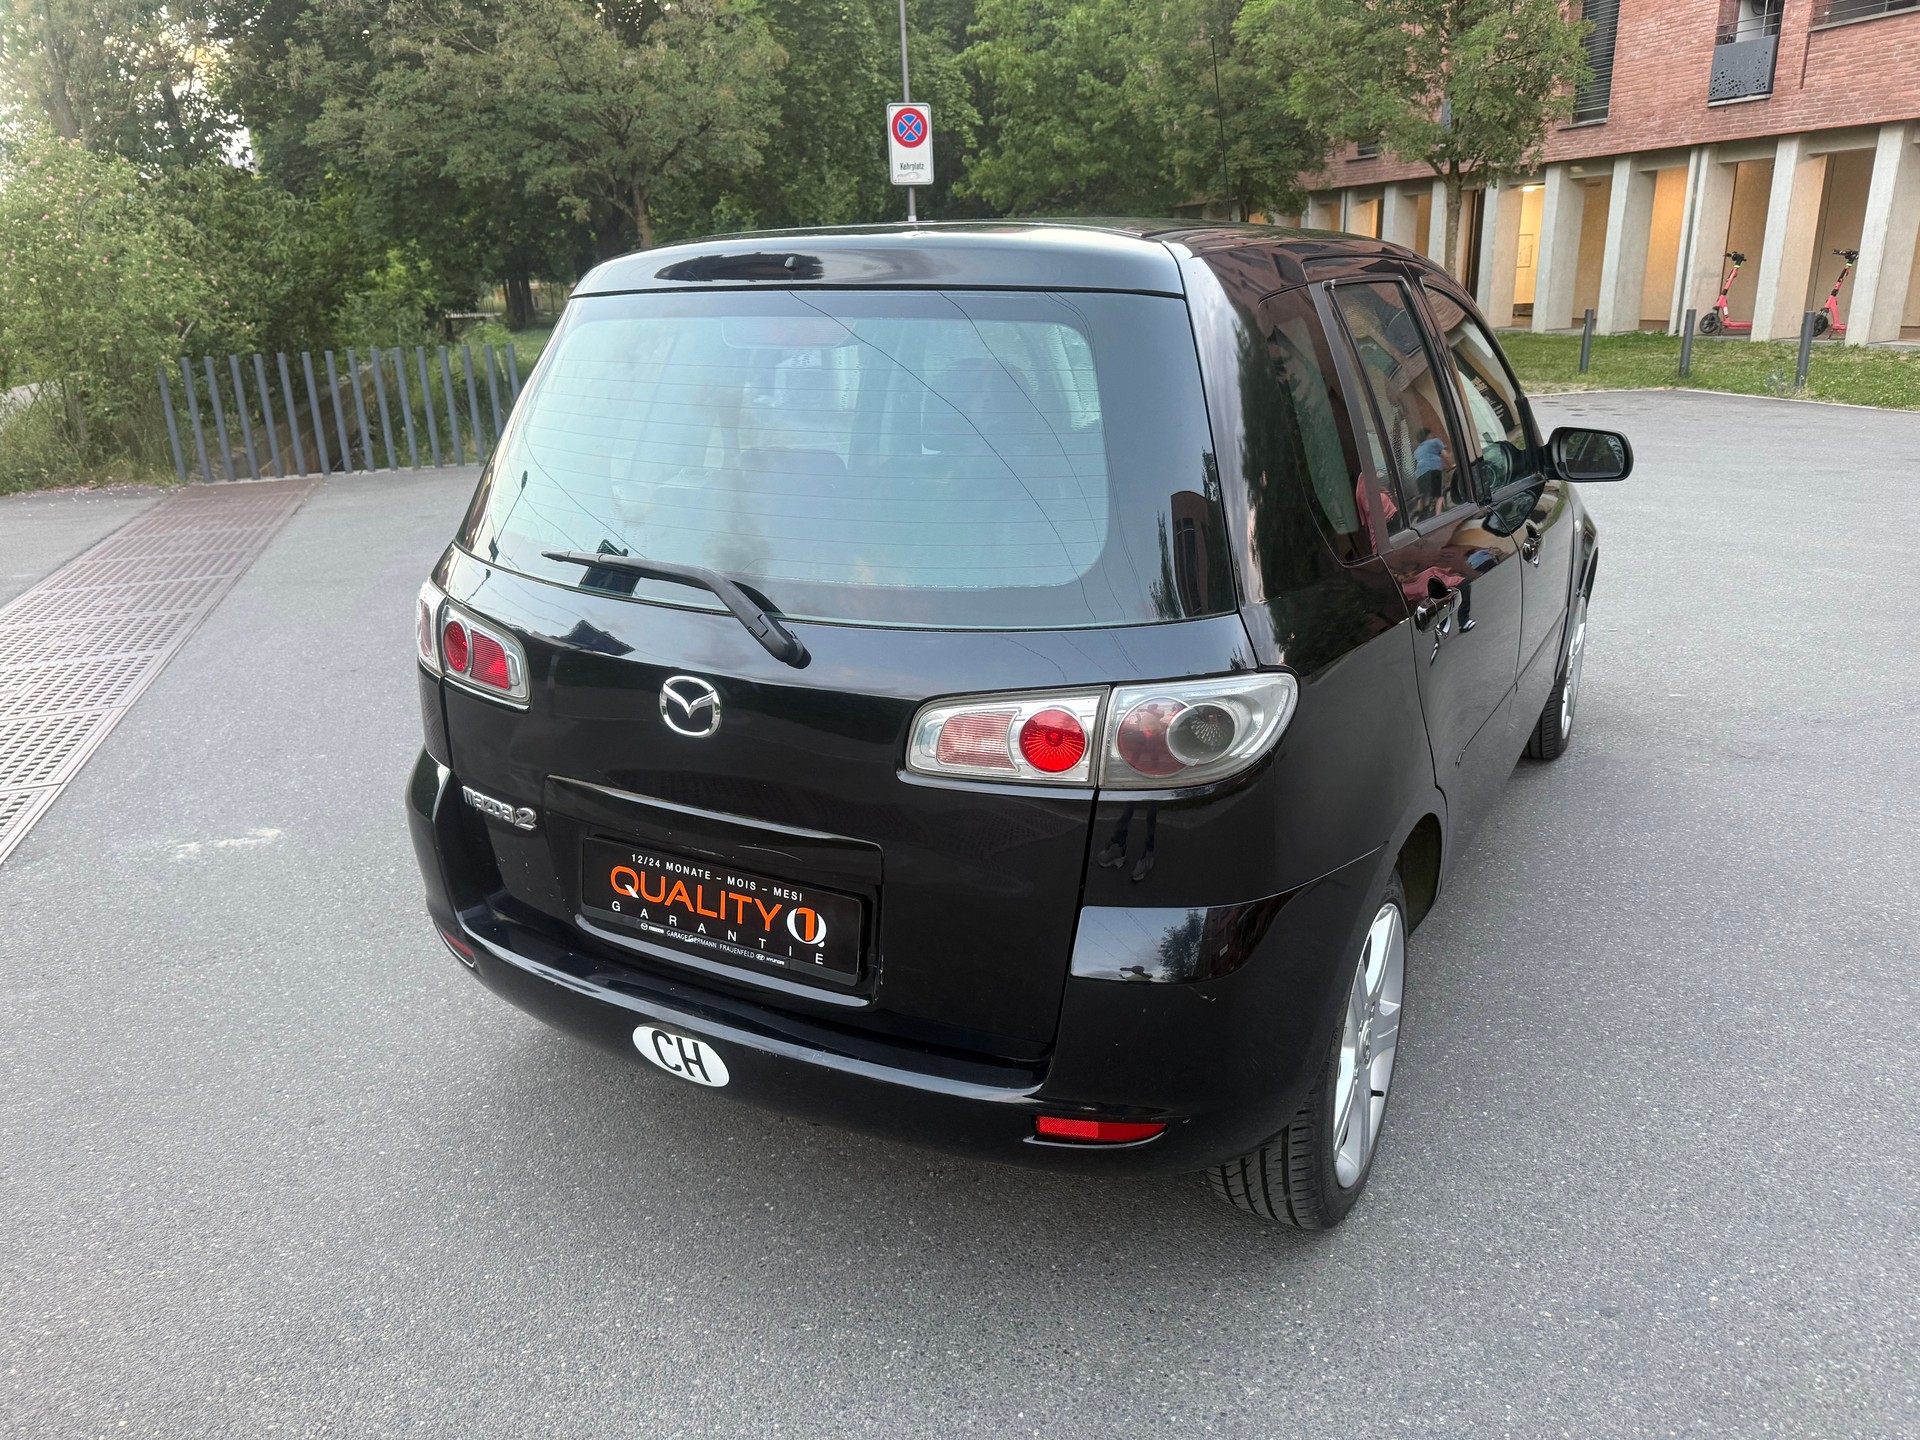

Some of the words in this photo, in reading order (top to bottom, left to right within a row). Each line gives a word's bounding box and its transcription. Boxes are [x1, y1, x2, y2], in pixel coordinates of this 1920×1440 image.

[610, 865, 783, 932] QUALITY
[631, 854, 661, 868] 12/24
[665, 861, 711, 880] MONATE
[727, 876, 757, 891] MOIS
[773, 887, 803, 902] MESI
[611, 900, 825, 965] GARANTIE
[666, 929, 688, 941] GARAGE
[719, 943, 755, 959] FRAUENFELD
[651, 1029, 712, 1083] CH
